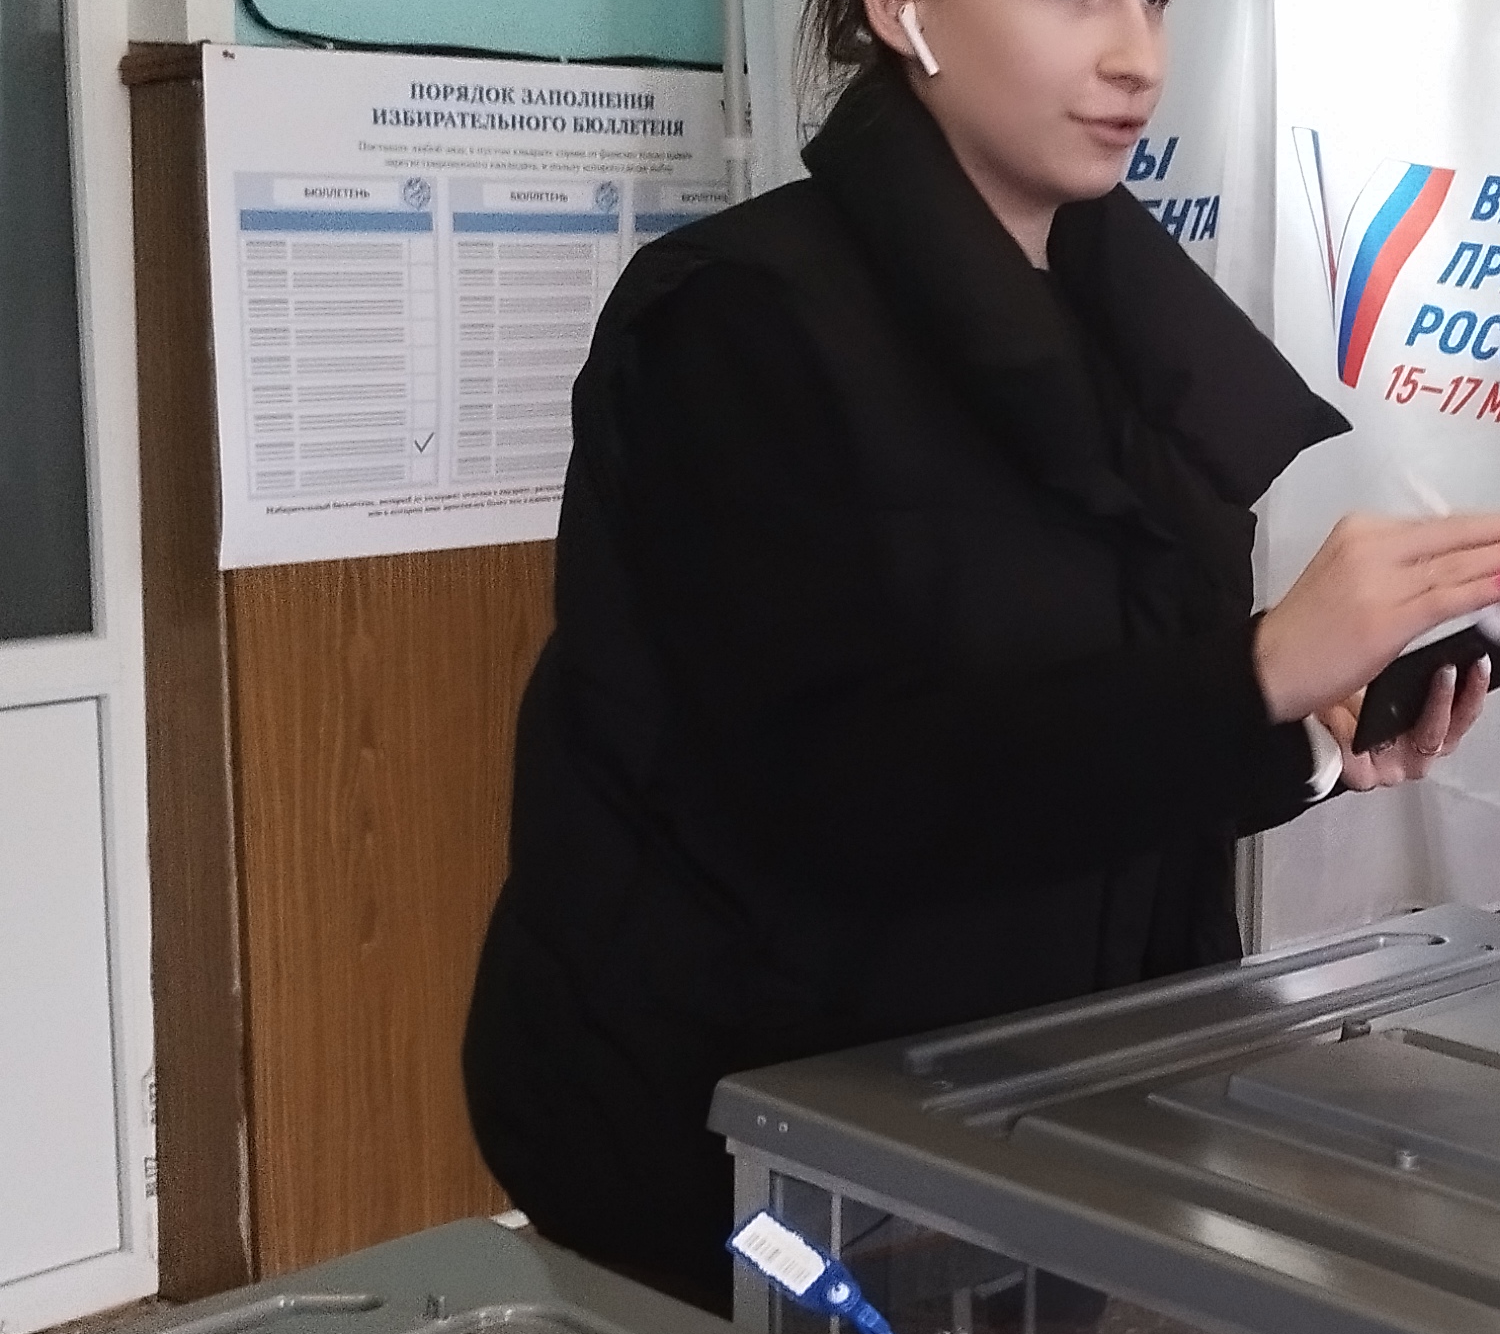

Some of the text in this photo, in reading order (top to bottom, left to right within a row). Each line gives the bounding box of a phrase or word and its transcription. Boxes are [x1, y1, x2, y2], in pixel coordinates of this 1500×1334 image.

[410, 82, 656, 111] ПОРЯДОК ЗАПОЛНЕНИЯ
[372, 107, 685, 137] ИЗБИРАТЕЛЬНОГО БЮЛЛЕТЕНЯ
